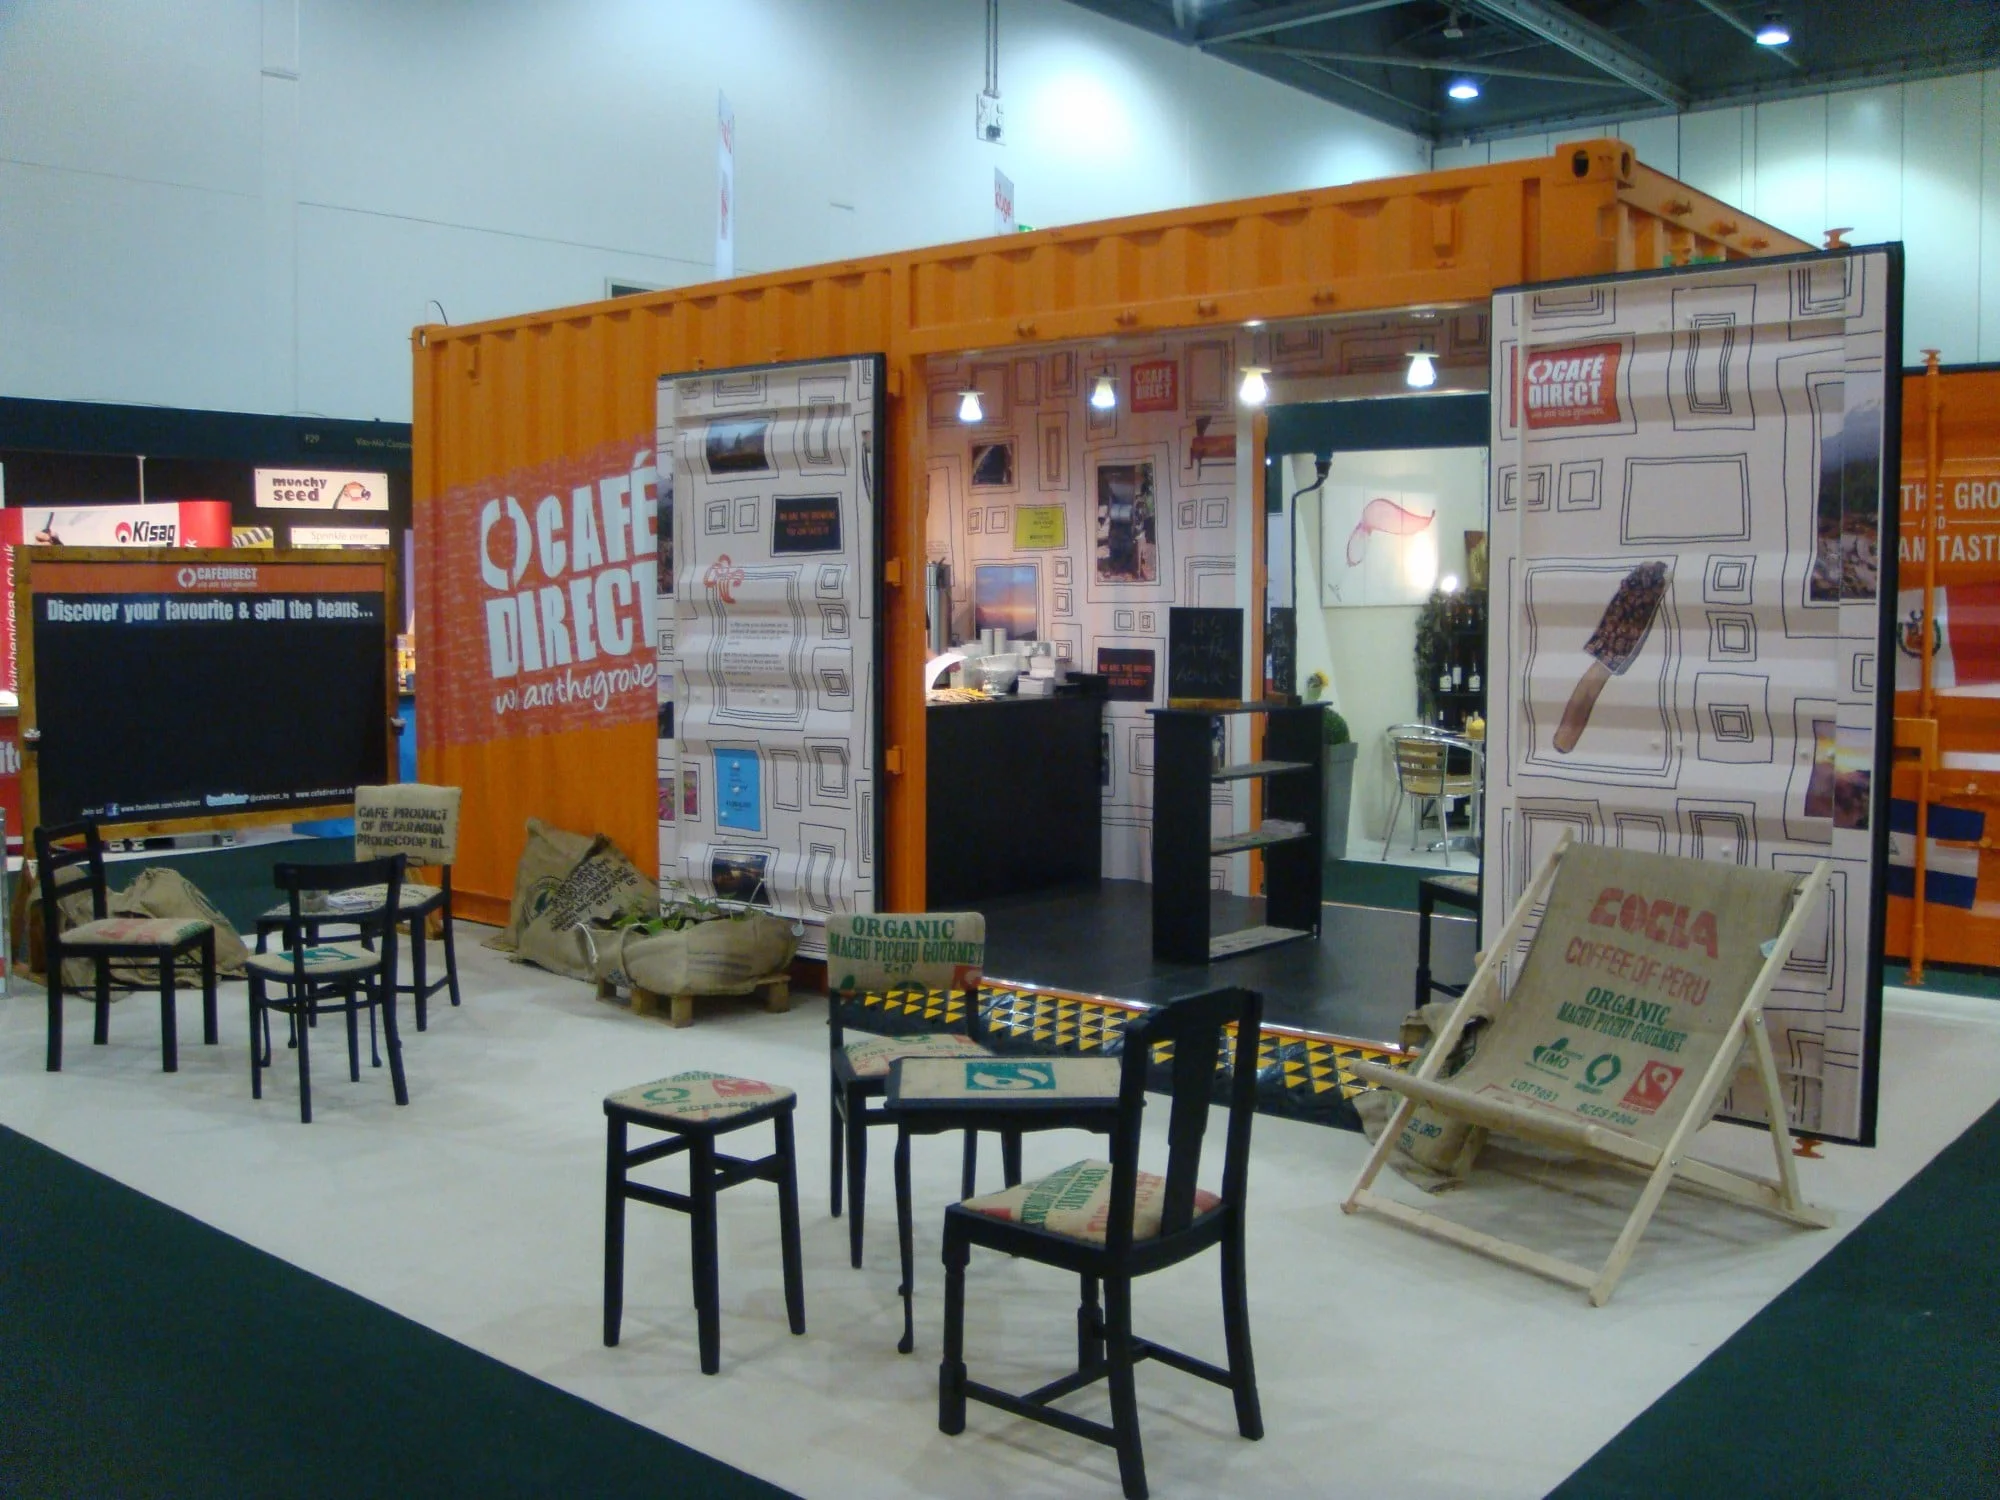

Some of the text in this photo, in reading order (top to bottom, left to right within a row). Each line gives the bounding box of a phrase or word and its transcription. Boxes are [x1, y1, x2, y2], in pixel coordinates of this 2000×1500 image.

[1528, 381, 1601, 409] DIRECT
[272, 477, 327, 489] munchy
[273, 488, 319, 501] seed
[536, 450, 657, 579] CAFÉ
[133, 521, 176, 547] Kisag
[1936, 534, 2000, 562] TAST
[47, 599, 373, 623] Discover your favourite & spill the beans...
[485, 560, 657, 679] DIRECT
[852, 916, 955, 939] ORGANIC
[1588, 887, 1719, 960] COCLA
[830, 932, 984, 965] MACHU PICCHU GOURMET
[1565, 936, 1711, 1007] COFFEE OF PERU
[1586, 986, 1672, 1026] ORGANIC
